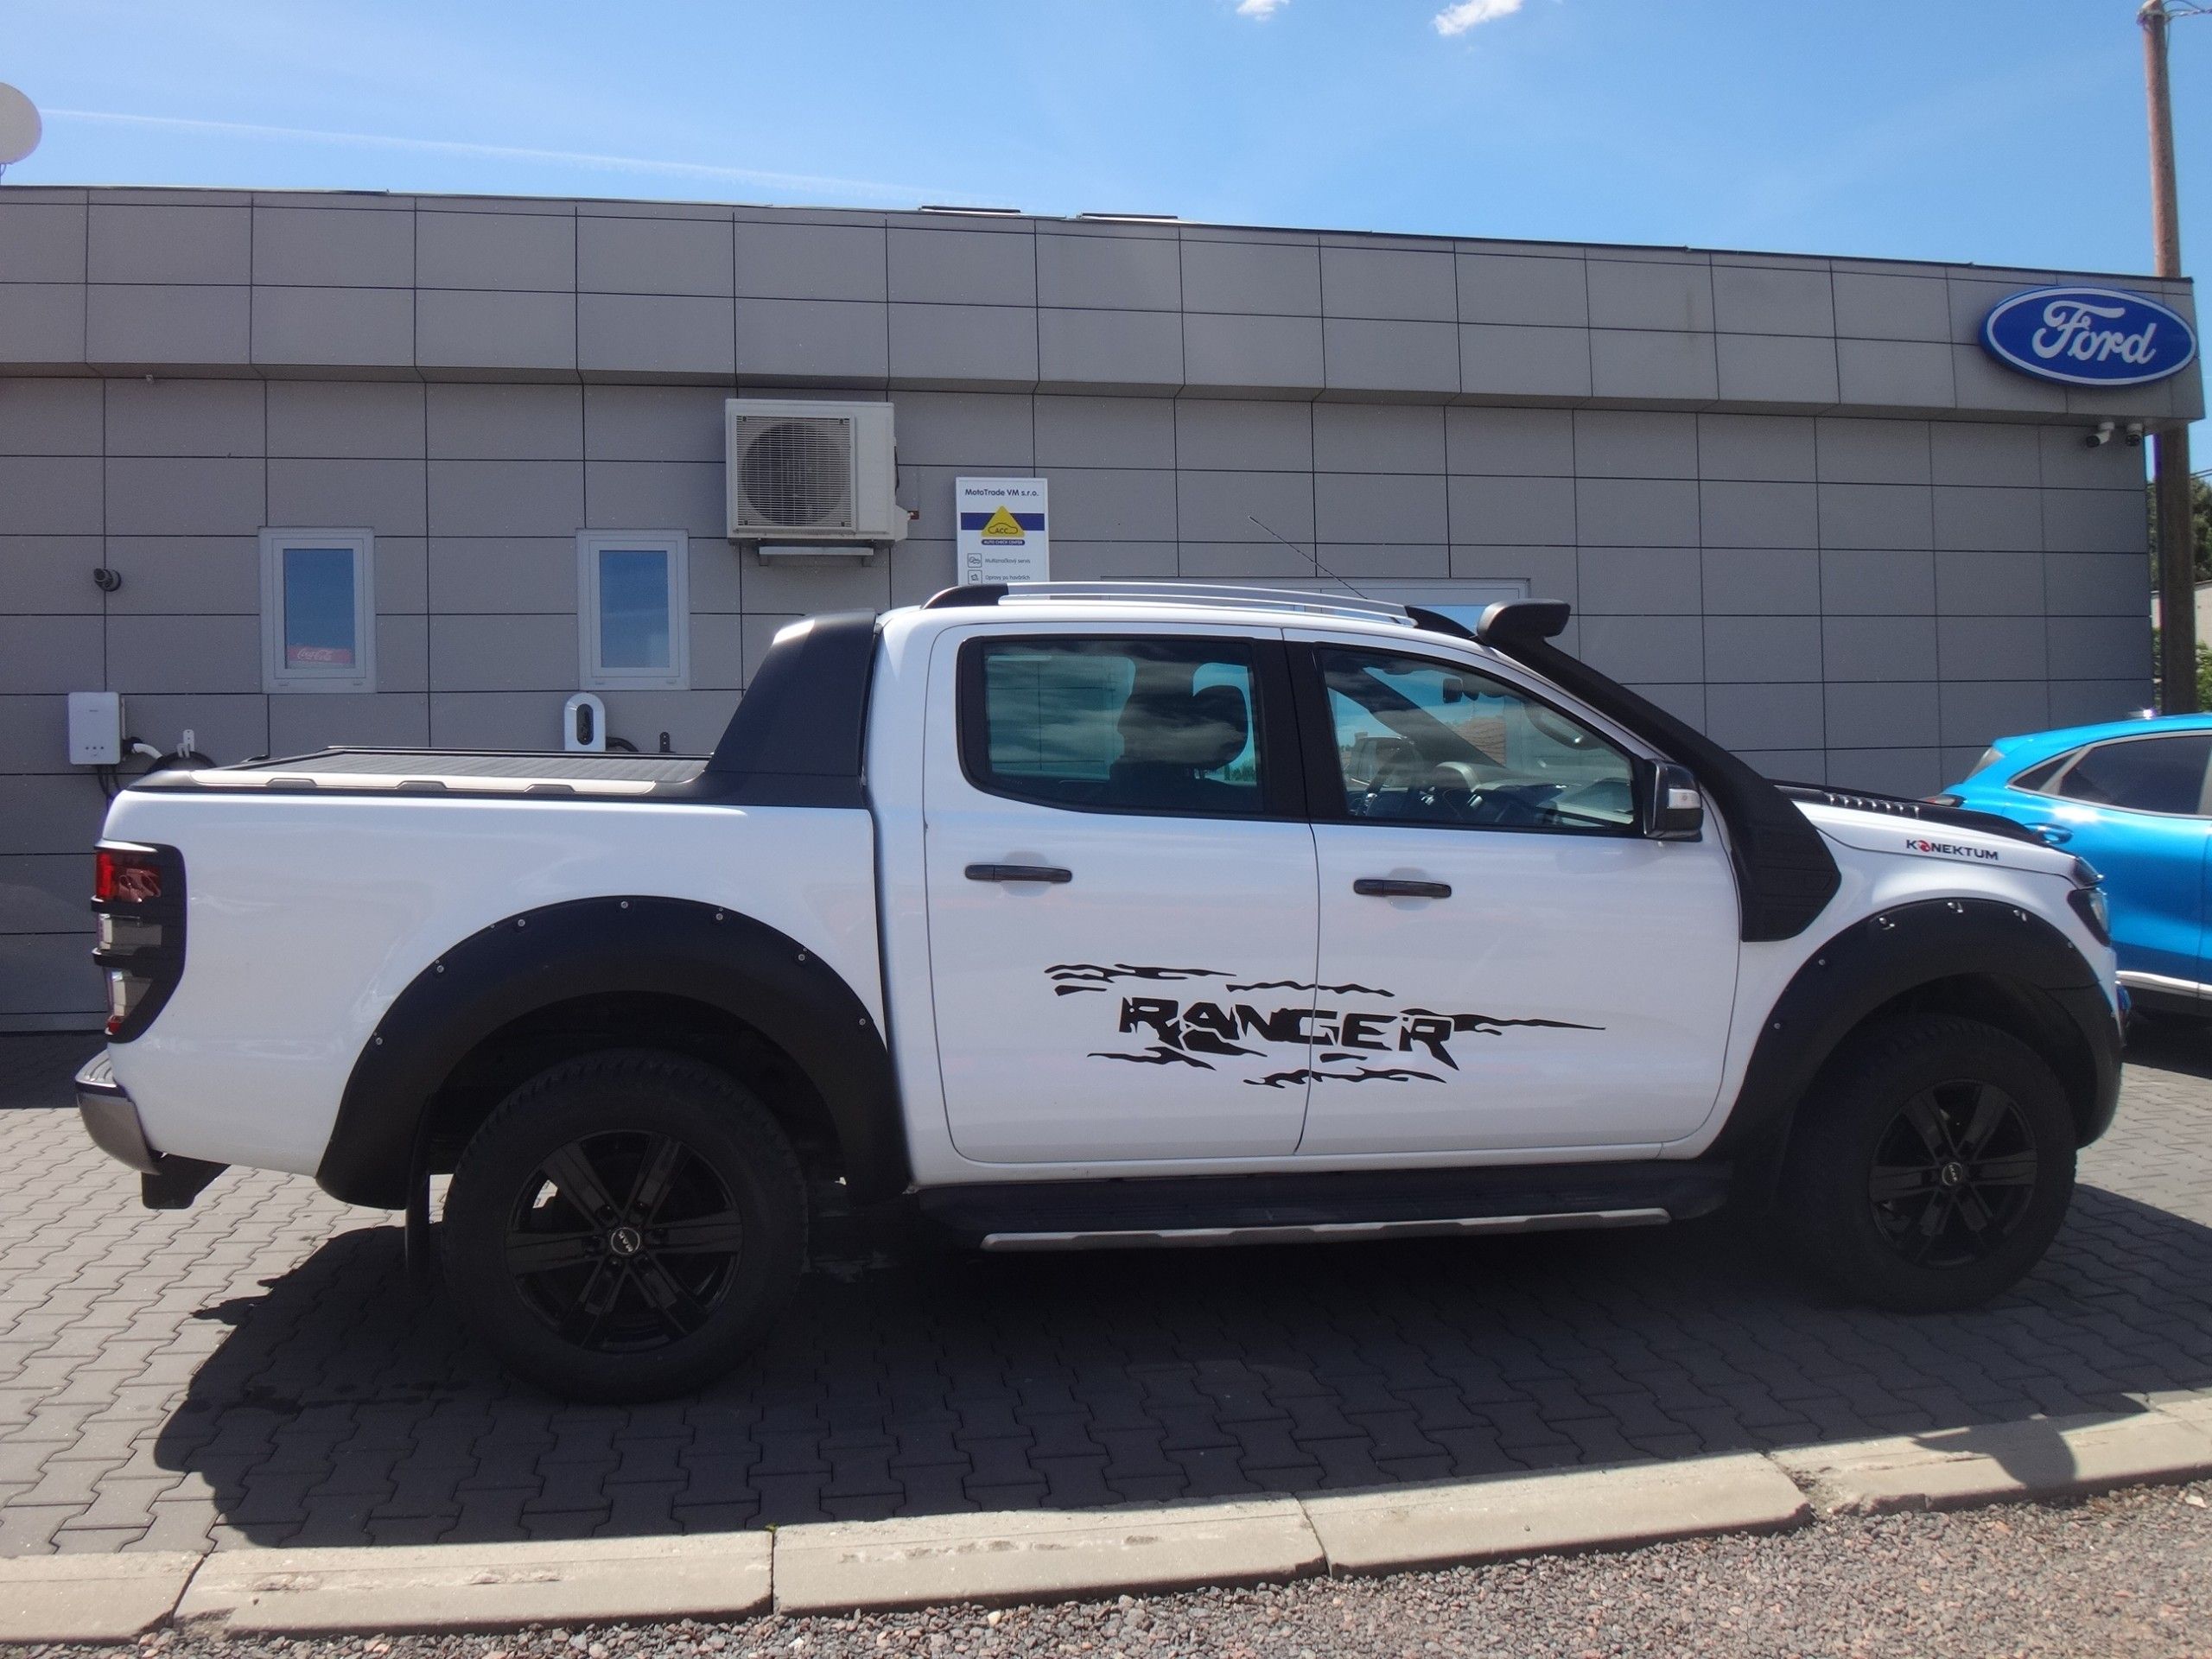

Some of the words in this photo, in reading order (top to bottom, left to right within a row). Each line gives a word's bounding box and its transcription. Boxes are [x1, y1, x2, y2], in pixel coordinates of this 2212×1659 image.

[2032, 300, 2157, 365] Ford
[1906, 839, 1999, 861] KONEKTUM
[1119, 996, 1460, 1071] RANGER
